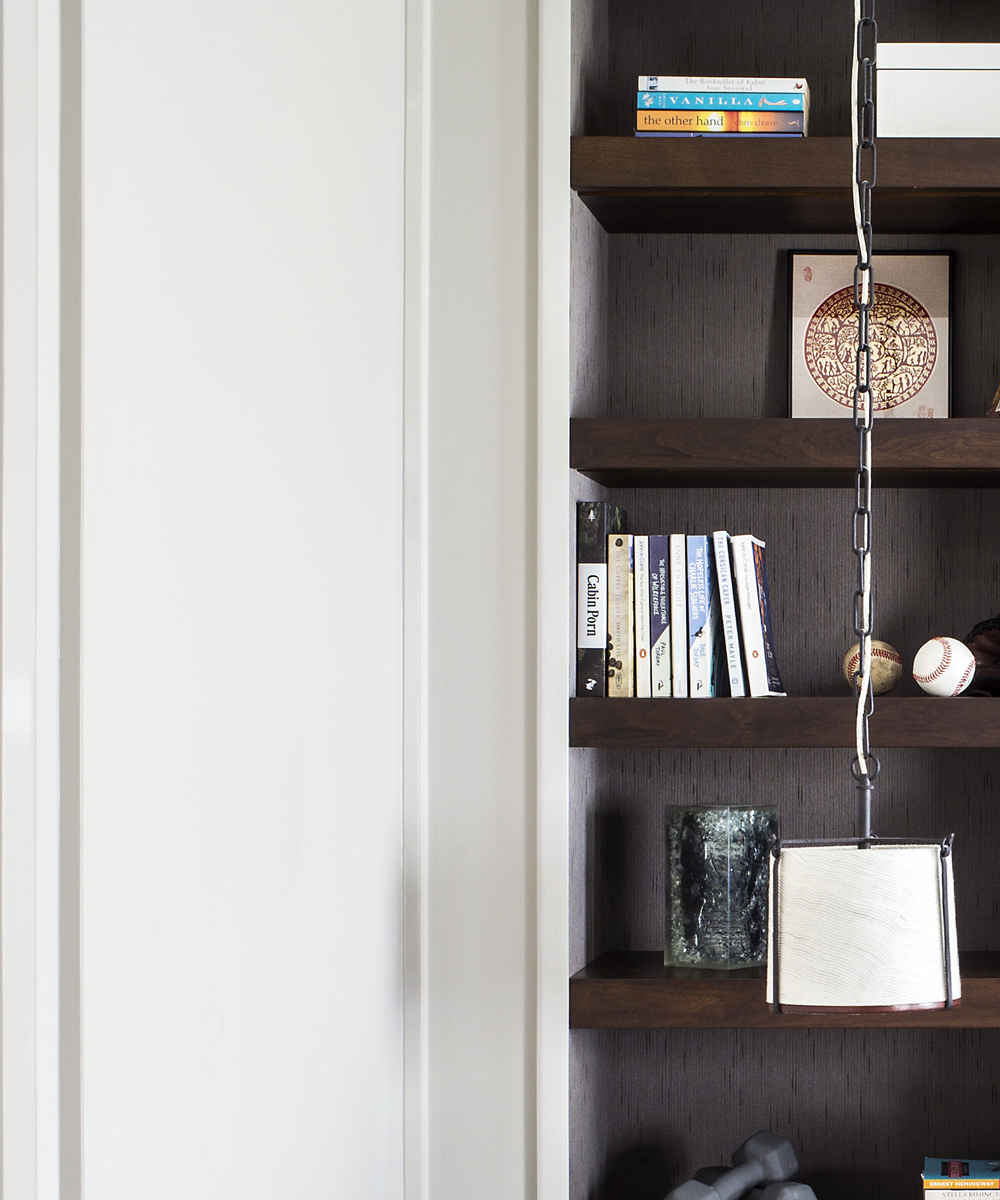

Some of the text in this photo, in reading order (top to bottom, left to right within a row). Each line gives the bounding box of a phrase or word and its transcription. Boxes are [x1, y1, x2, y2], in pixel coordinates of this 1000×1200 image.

[669, 96, 753, 105] VANILLA
[644, 115, 724, 126] the other hand
[735, 118, 778, 126] chris cleave
[696, 558, 705, 590] HOPELESS
[718, 550, 728, 583] CORSICAN
[689, 562, 699, 620] CHARLIE SUMMERS
[697, 591, 705, 605] LIFE
[722, 585, 730, 605] CAPER
[587, 574, 600, 636] Cabin Porn
[725, 614, 734, 640] PETER
[728, 643, 737, 669] MAYLE
